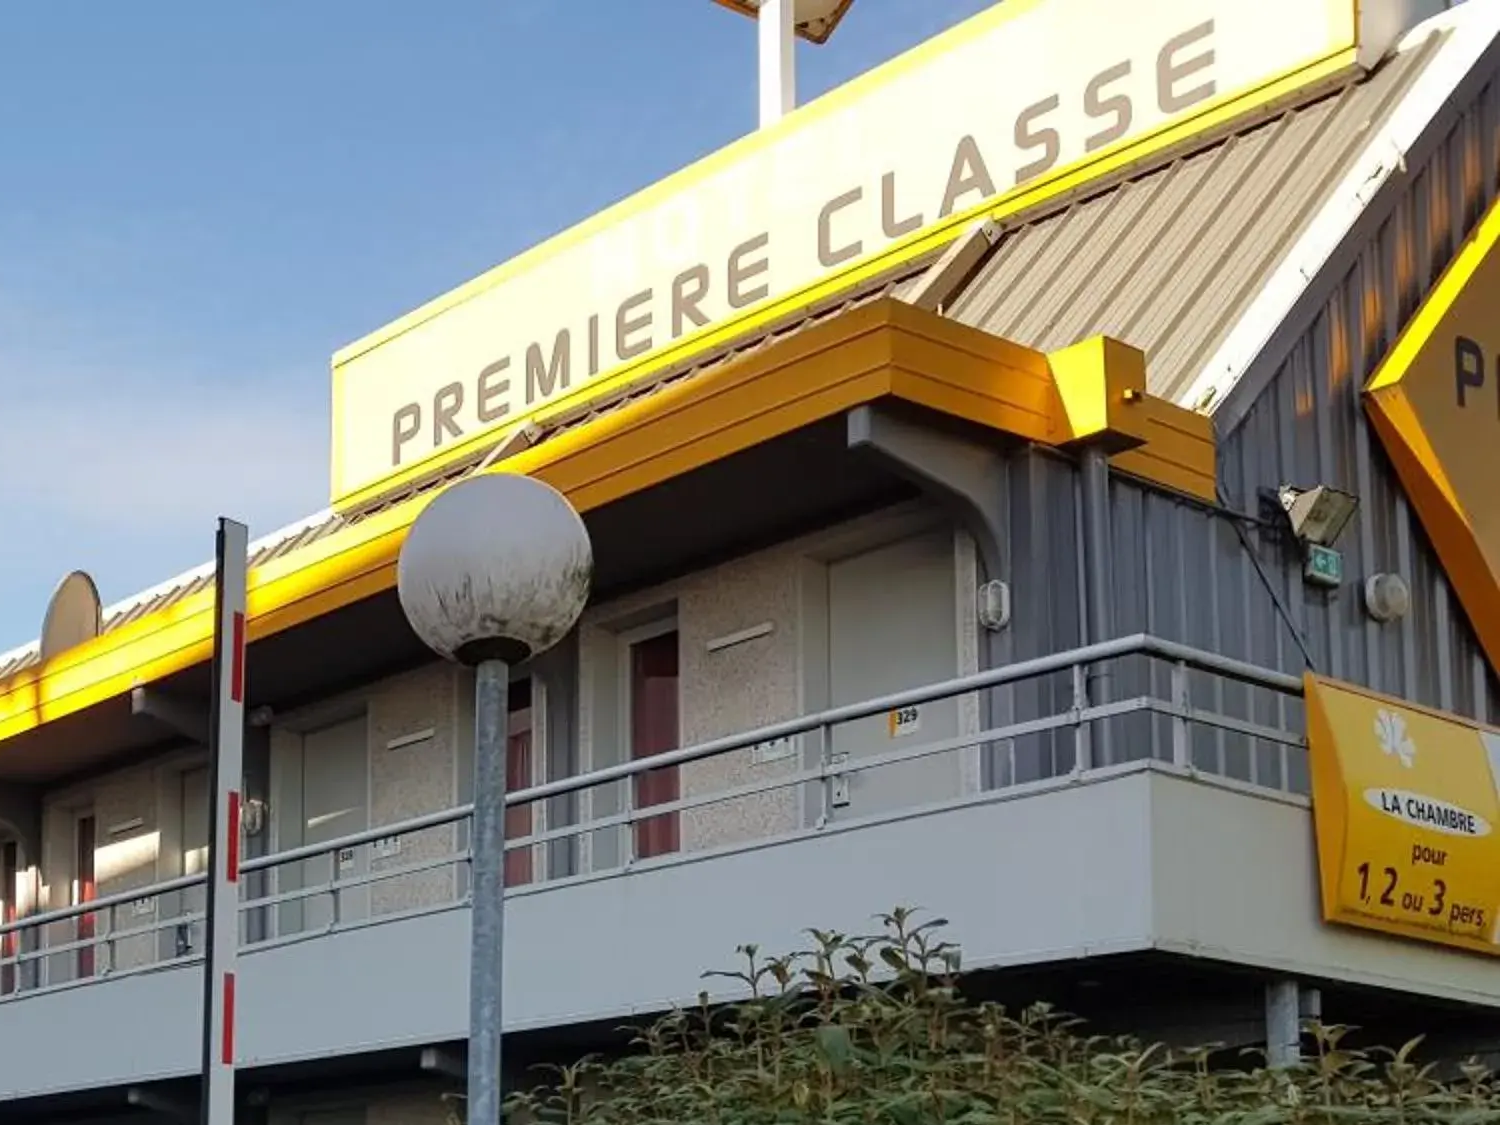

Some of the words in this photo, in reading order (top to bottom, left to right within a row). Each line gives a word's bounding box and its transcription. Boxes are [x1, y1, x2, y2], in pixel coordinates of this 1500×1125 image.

[392, 231, 770, 466] PREMIERE
[816, 18, 1217, 269] CLASSE
[1454, 334, 1500, 423] P
[1380, 790, 1403, 816] LA
[1406, 799, 1476, 834] CHAMBRE
[1411, 844, 1448, 865] pour
[1356, 861, 1371, 905] 1,
[1380, 866, 1398, 907] 2
[1402, 892, 1425, 913] ou
[1428, 878, 1447, 916] 3
[1451, 903, 1488, 928] pers.
